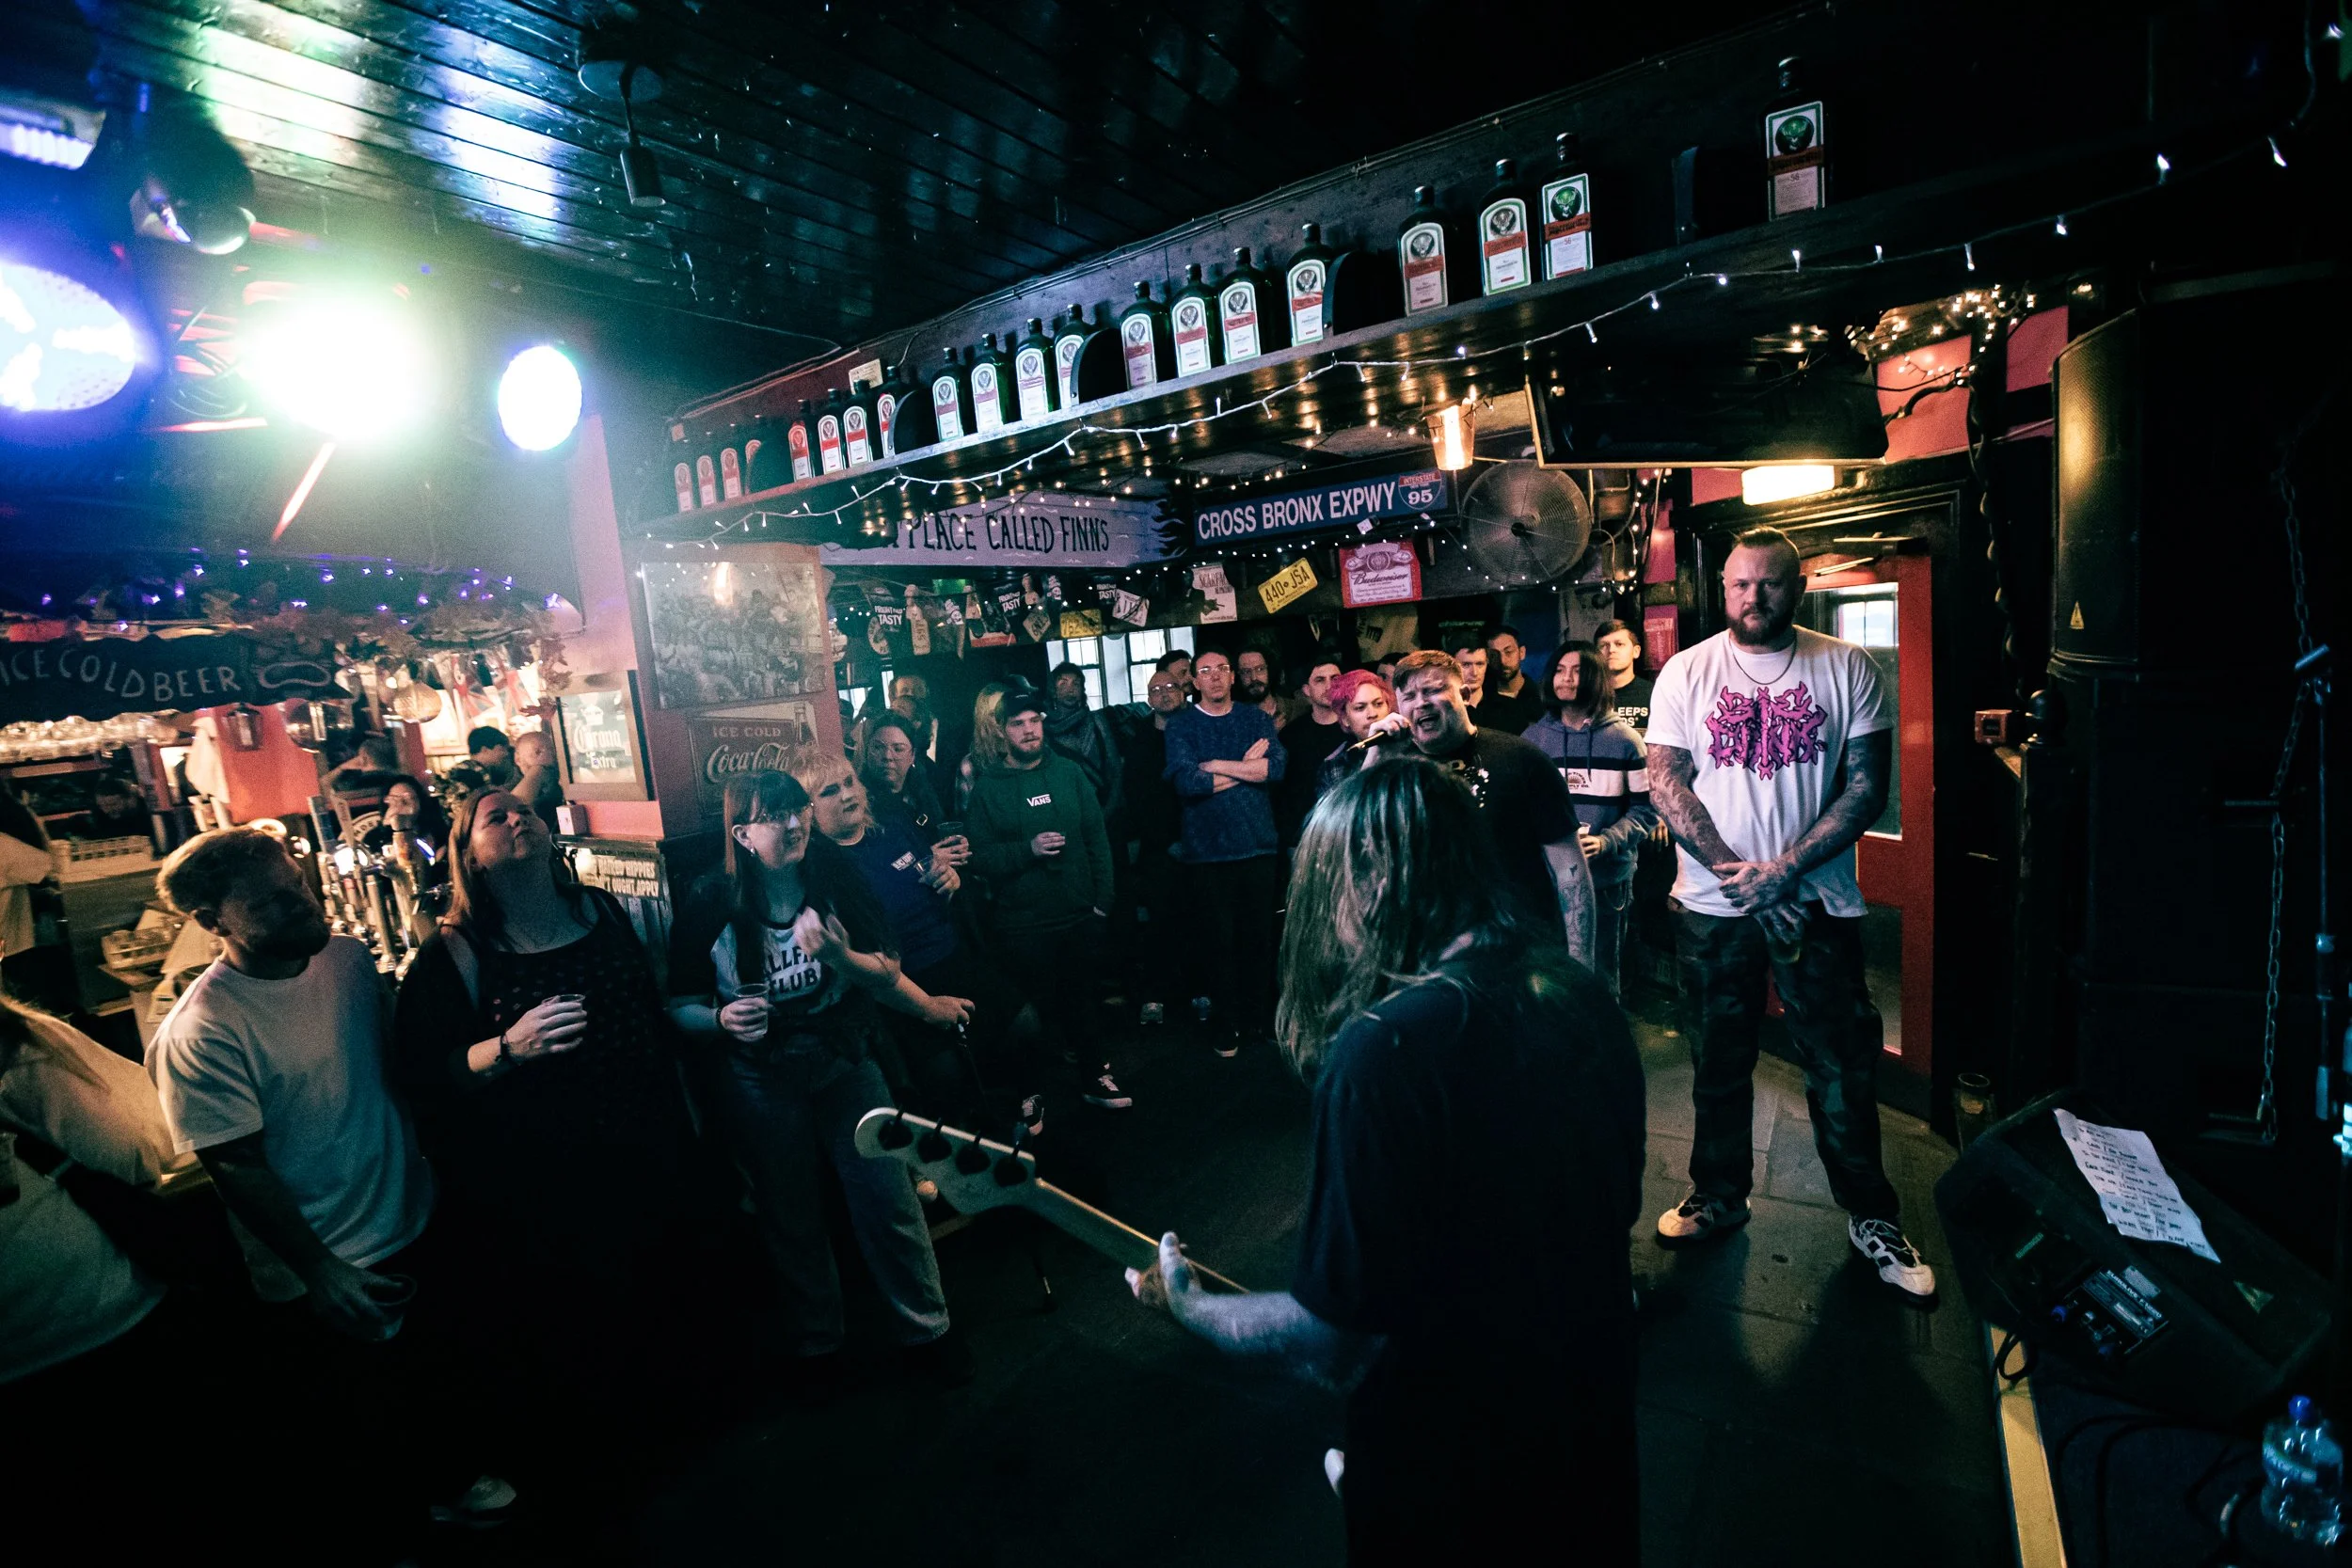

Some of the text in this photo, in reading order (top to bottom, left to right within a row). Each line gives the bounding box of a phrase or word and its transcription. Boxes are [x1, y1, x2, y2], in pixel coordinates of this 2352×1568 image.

[1407, 488, 1433, 505] 95
[1198, 481, 1397, 540] CROSS BRONX EXPWY
[899, 513, 977, 551] PLACE
[987, 513, 1055, 553] CALLED
[1060, 515, 1109, 552] FINNS
[1264, 579, 1286, 603] 440
[1290, 565, 1311, 589] JSA
[1350, 569, 1408, 585] Budweiser
[1001, 596, 1021, 612] TASTY
[877, 614, 902, 626] TASTY
[0, 649, 241, 703] ICE COLD BEER
[574, 719, 622, 753] Corona
[713, 726, 782, 737] ICE COLD
[1026, 794, 1051, 807] VANS
